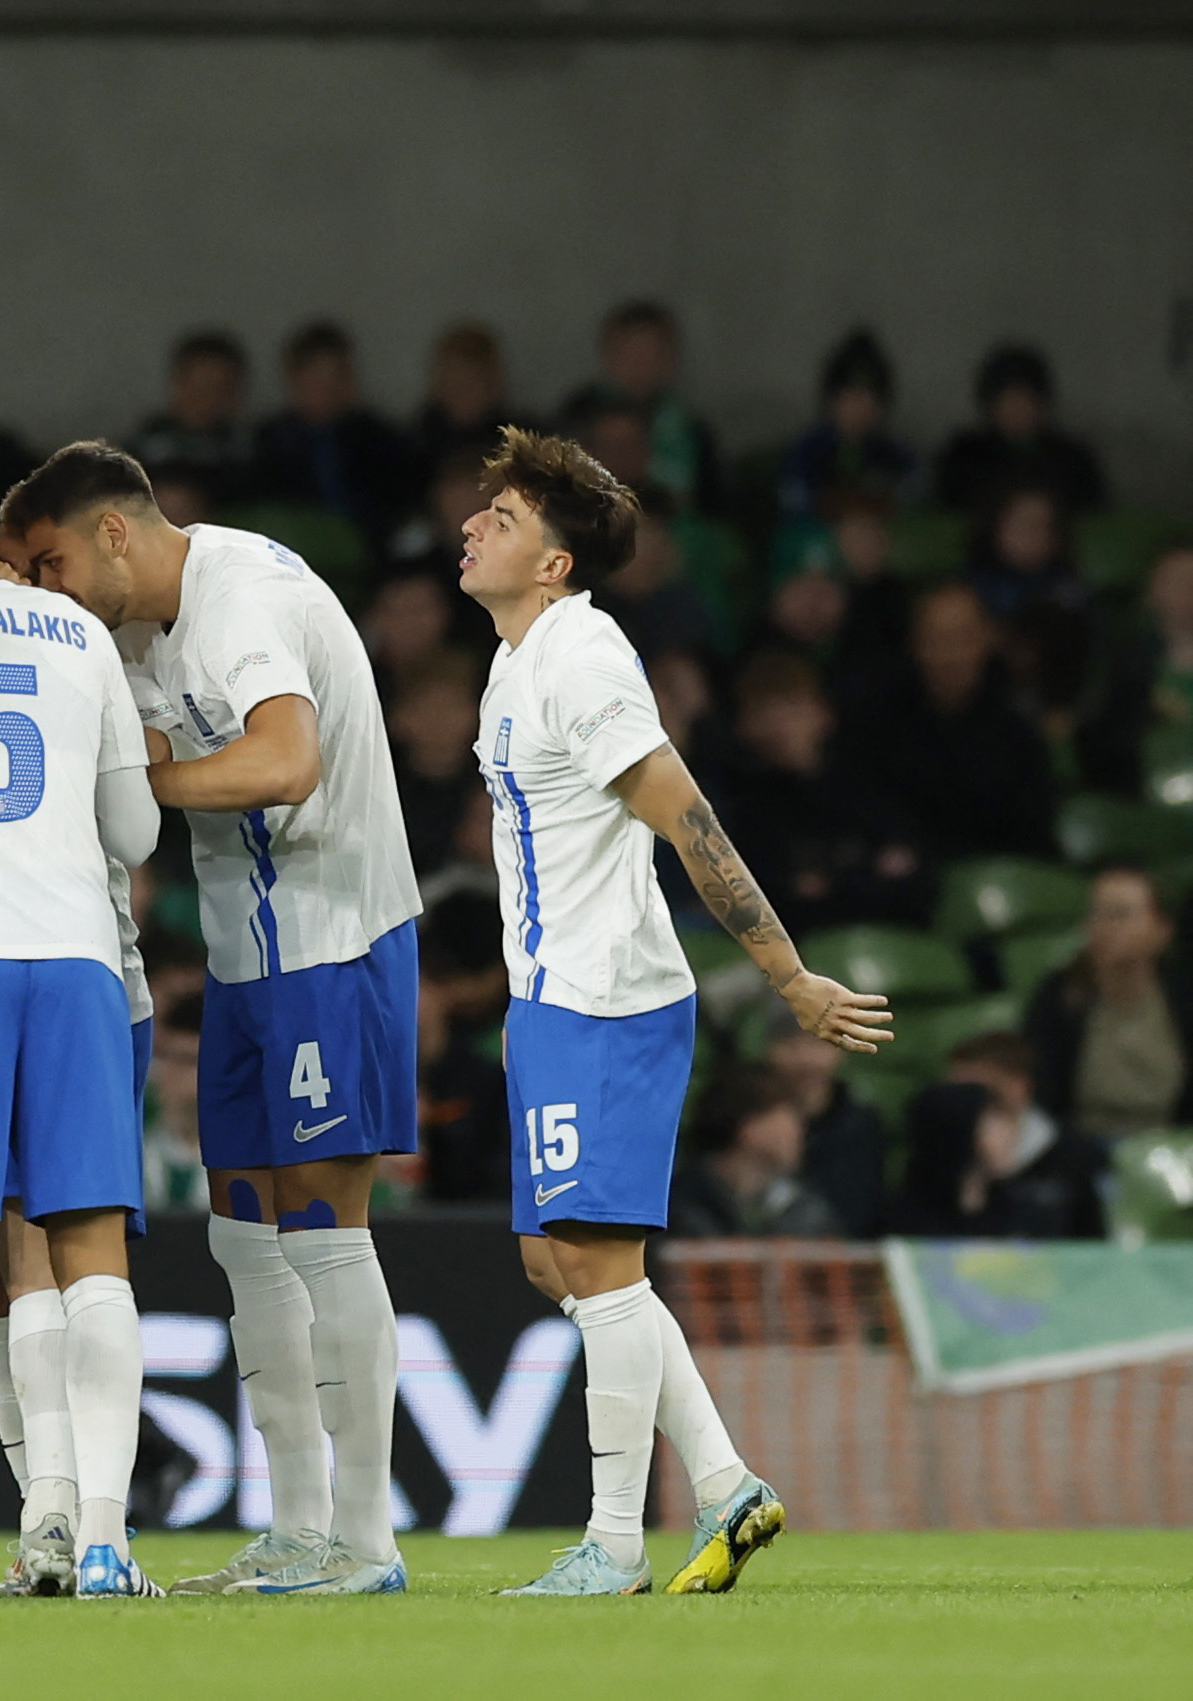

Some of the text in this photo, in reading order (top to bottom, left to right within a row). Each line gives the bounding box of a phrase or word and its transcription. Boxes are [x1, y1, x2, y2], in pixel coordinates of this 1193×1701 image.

[289, 1040, 332, 1110] 4
[525, 1102, 580, 1177] 15
[134, 1312, 584, 1538] sy
